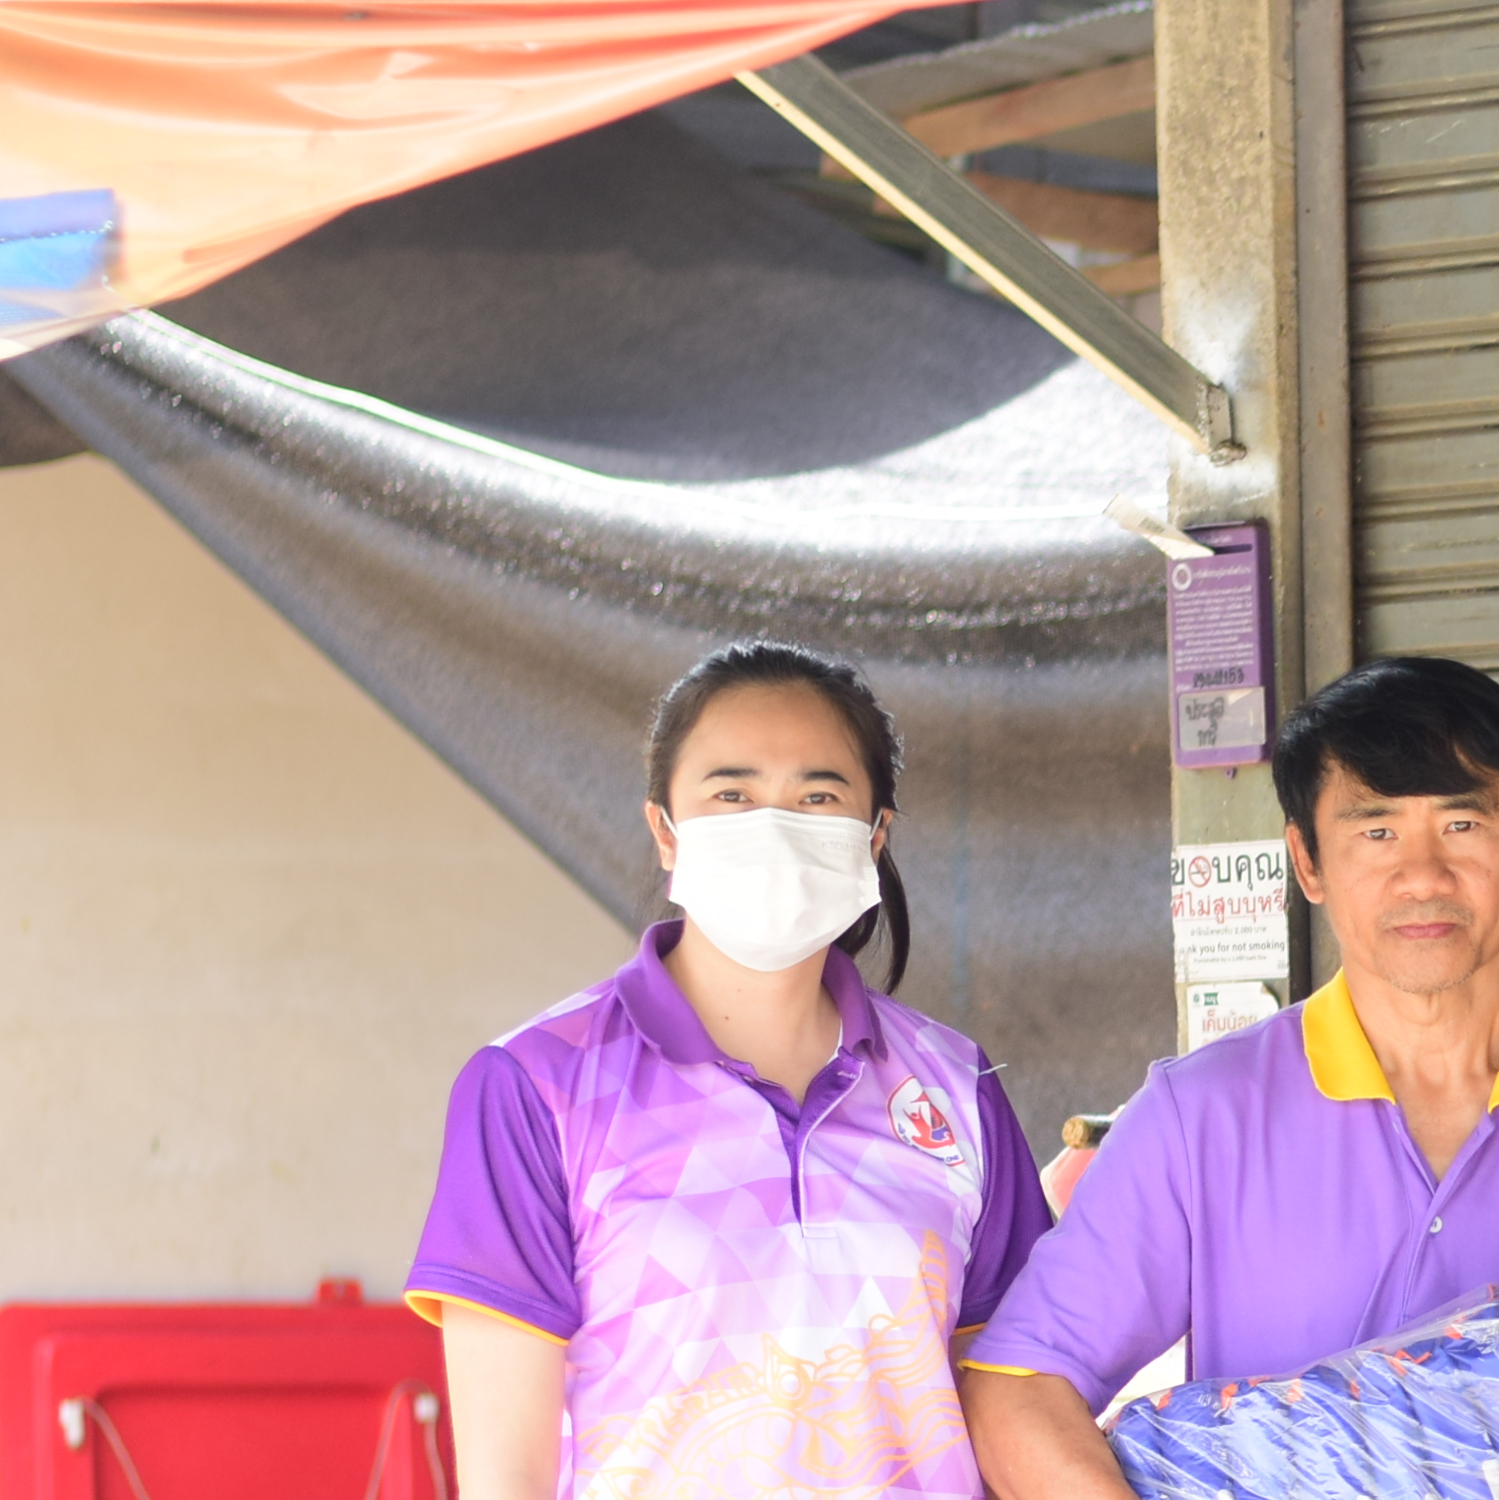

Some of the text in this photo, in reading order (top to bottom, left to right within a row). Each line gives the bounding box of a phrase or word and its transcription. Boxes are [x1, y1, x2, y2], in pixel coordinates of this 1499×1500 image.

[1172, 882, 1285, 924] ที่ไม่สูบบุหรี่
[1235, 926, 1253, 934] 2,000
[1200, 945, 1215, 955] you
[1217, 942, 1230, 952] for
[1232, 943, 1246, 951] not
[1249, 940, 1285, 951] smoking
